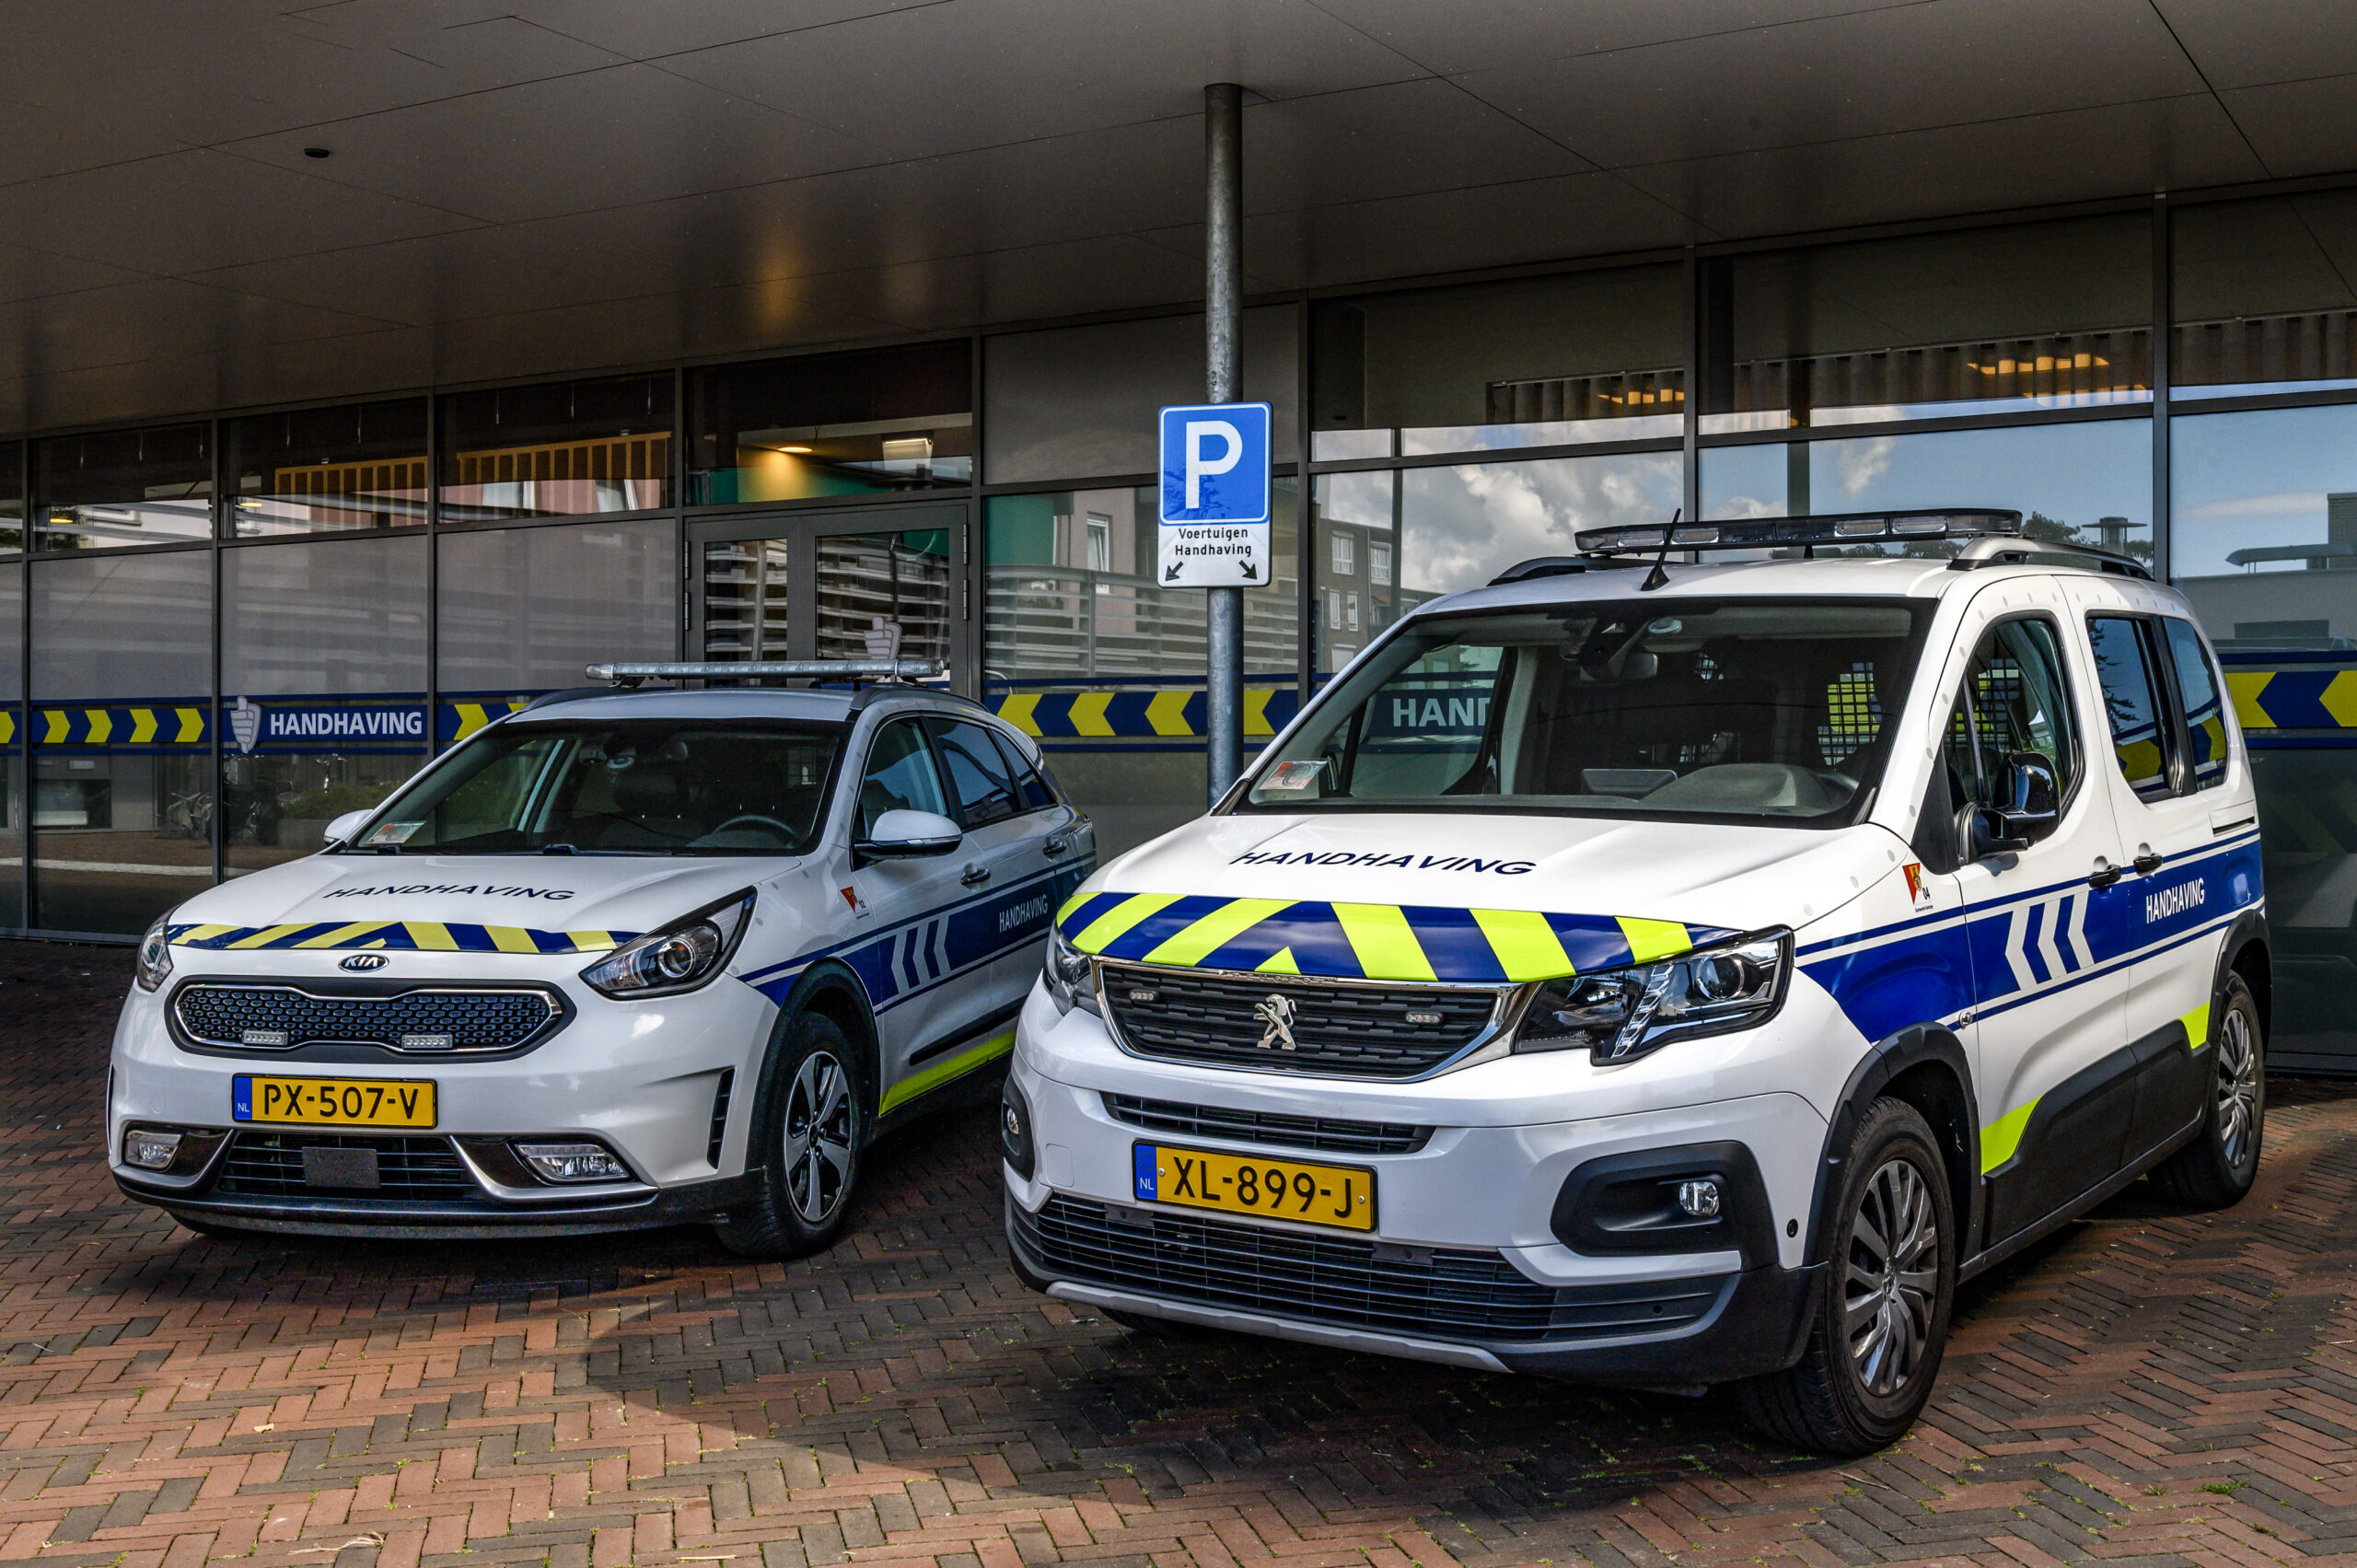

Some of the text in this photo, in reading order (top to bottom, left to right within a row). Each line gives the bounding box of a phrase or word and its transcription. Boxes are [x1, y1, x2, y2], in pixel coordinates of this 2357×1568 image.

[1186, 420, 1243, 509] P
[1178, 528, 1248, 541] Voertuigen
[1175, 543, 1252, 558] Handhaving
[270, 712, 423, 735] HANDHAVING
[1229, 852, 1538, 876] HANDHAVING
[323, 884, 575, 900] HANDHAVING
[2146, 877, 2205, 924] HANDHAVING
[999, 893, 1049, 933] HANDHAVING
[343, 955, 379, 969] KIA
[237, 1084, 419, 1120] NL PX-507-V
[1139, 1156, 1353, 1219] NL XL-899-J
